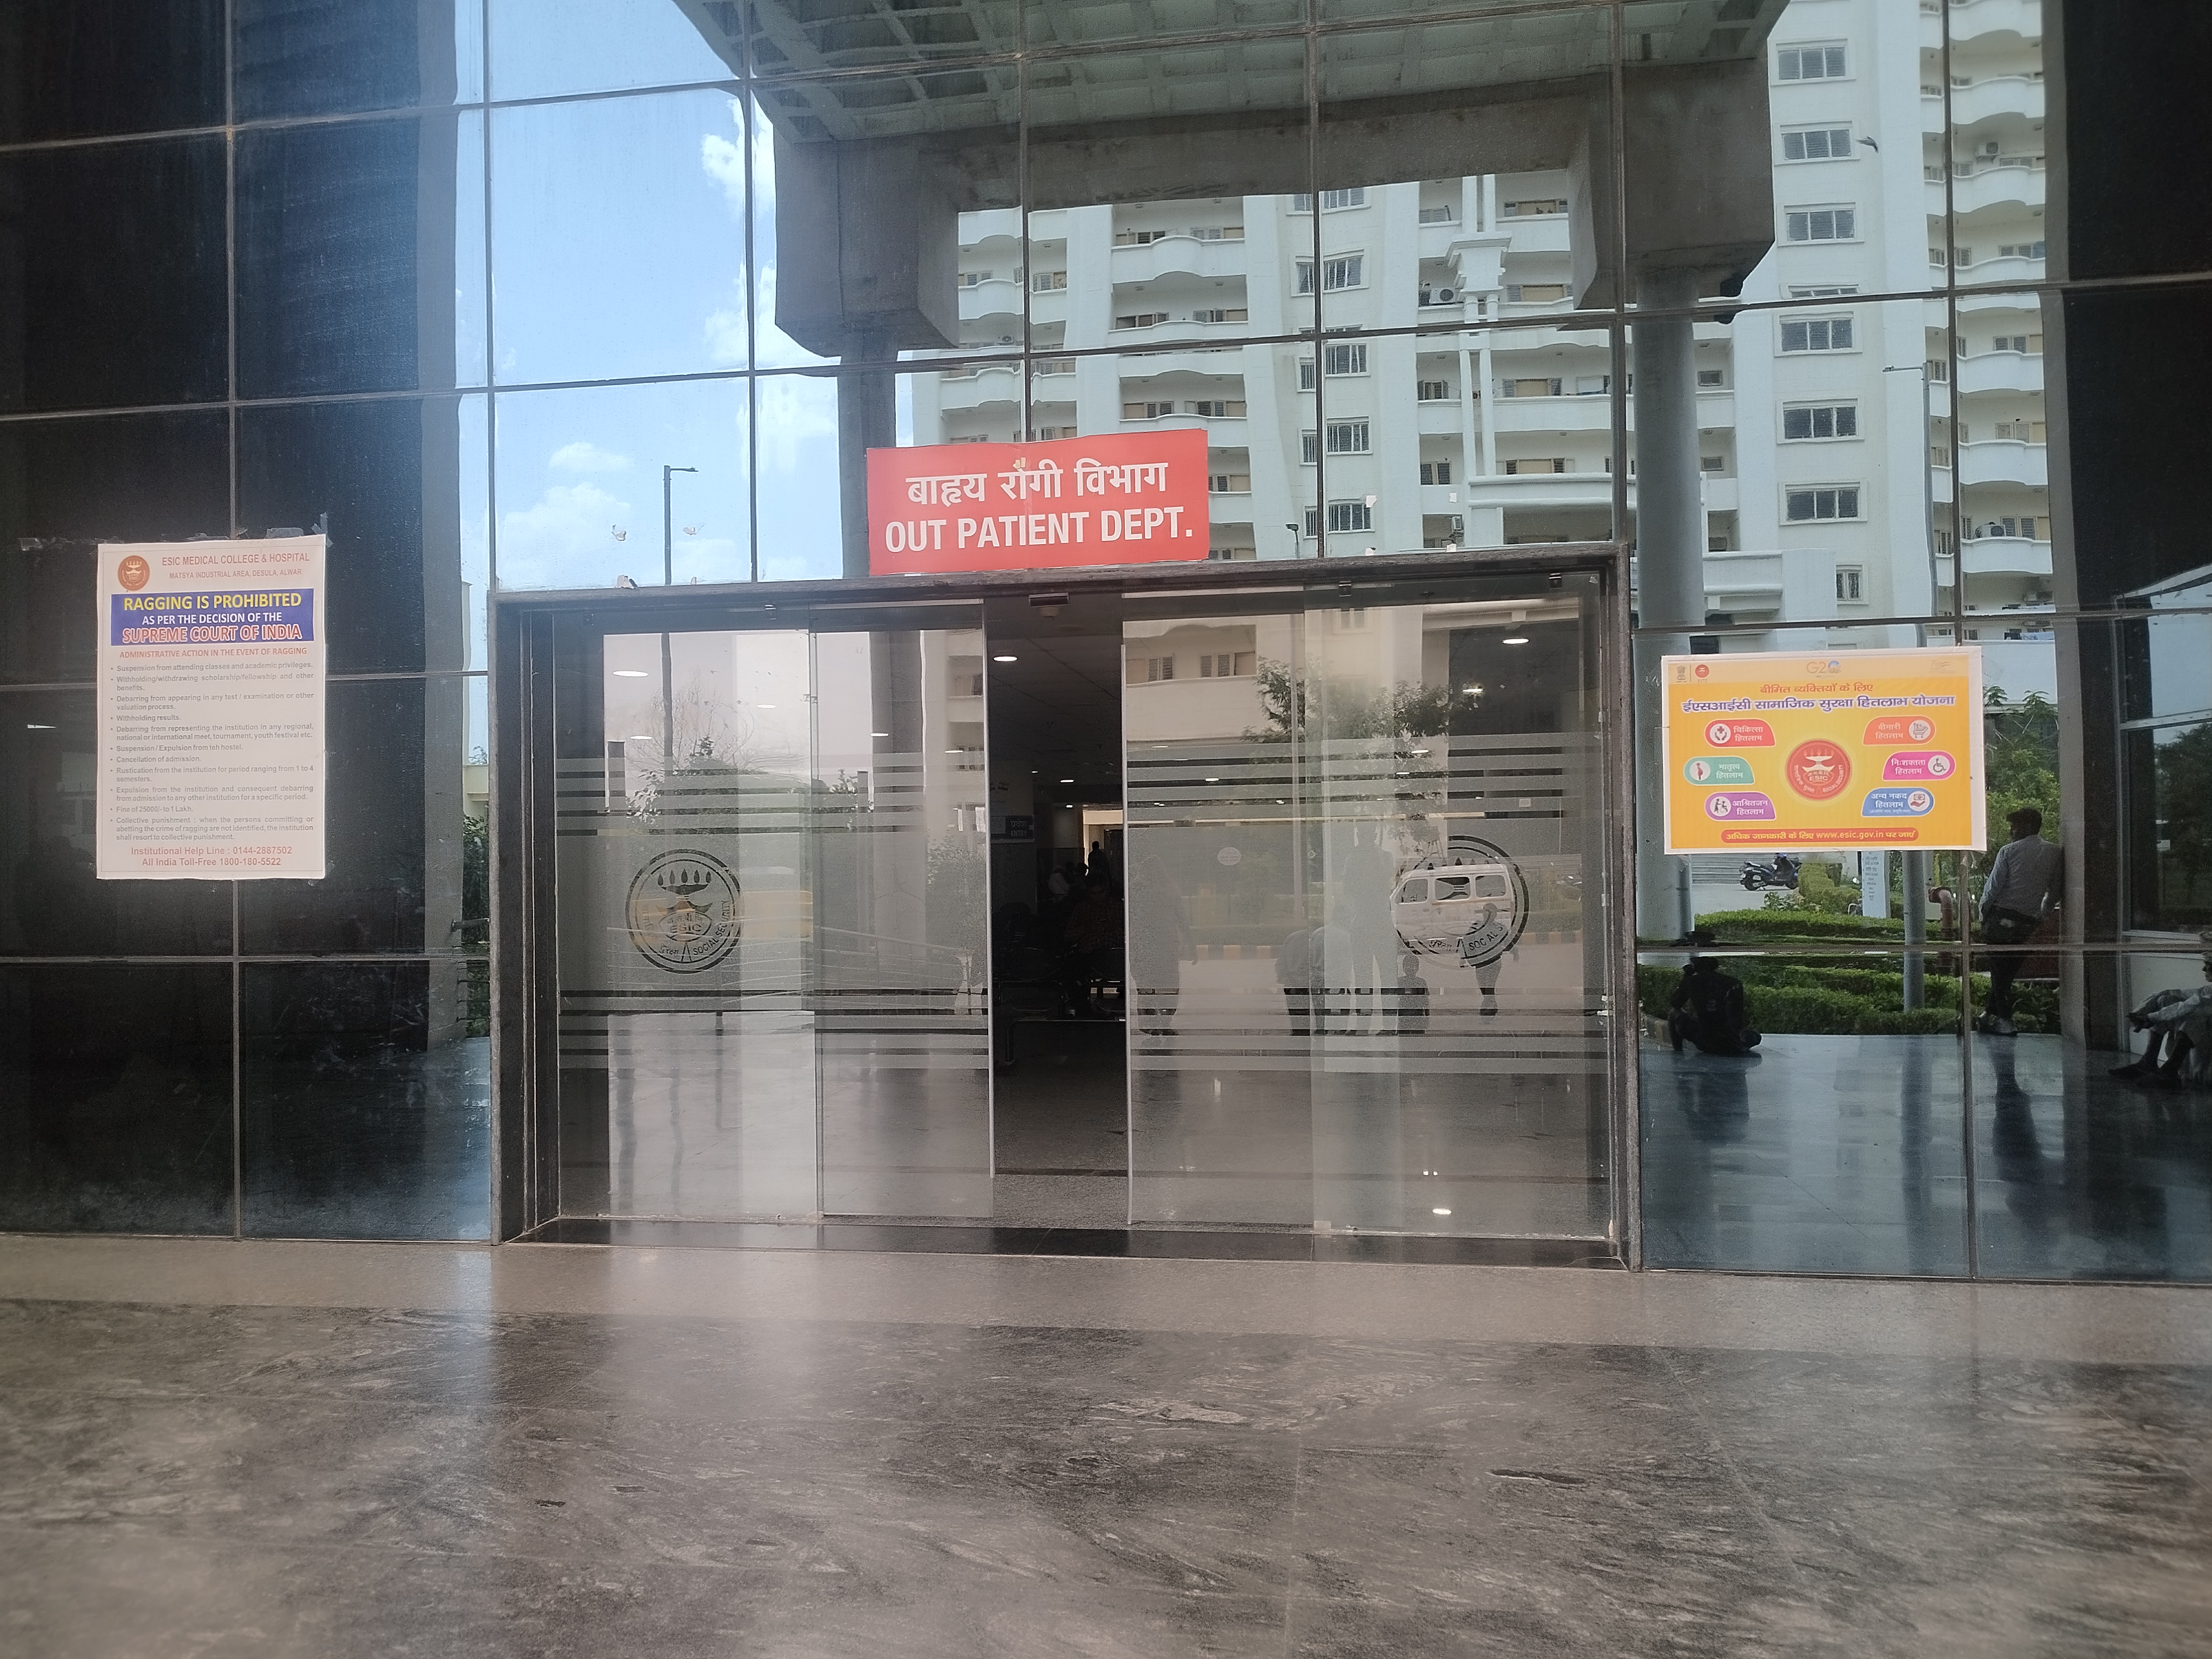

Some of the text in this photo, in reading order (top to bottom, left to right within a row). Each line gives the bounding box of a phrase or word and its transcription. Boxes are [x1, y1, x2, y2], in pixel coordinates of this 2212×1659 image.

[1073, 457, 1169, 497] विभाग
[885, 506, 1193, 553] OUT PATIENT DEPT.
[162, 552, 309, 566] ESIC MEDICAL COLLEGE & HOSPITAL
[123, 593, 301, 611] RAGGING IS PROHIBITED
[142, 612, 281, 625] AS PER THE DECISION OF THE
[122, 624, 302, 643] SUPREME COURT OF INDIA
[1760, 682, 1874, 693] बीमित व्यक्तियों के लिए
[168, 694, 201, 702] appearing
[1682, 694, 1955, 712] ईएसआईसी सामाजिक सुरक्षा हितलाभ योजना
[1752, 831, 1787, 839] जानकारी
[1815, 830, 1884, 840] www.esic.gov.in
[131, 847, 181, 855] Institutional
[184, 847, 204, 856] Help
[206, 846, 225, 854] Line
[220, 857, 281, 865] 1800-180-5522
[670, 924, 702, 933] ESIC
[693, 937, 719, 956] SOCIAL
